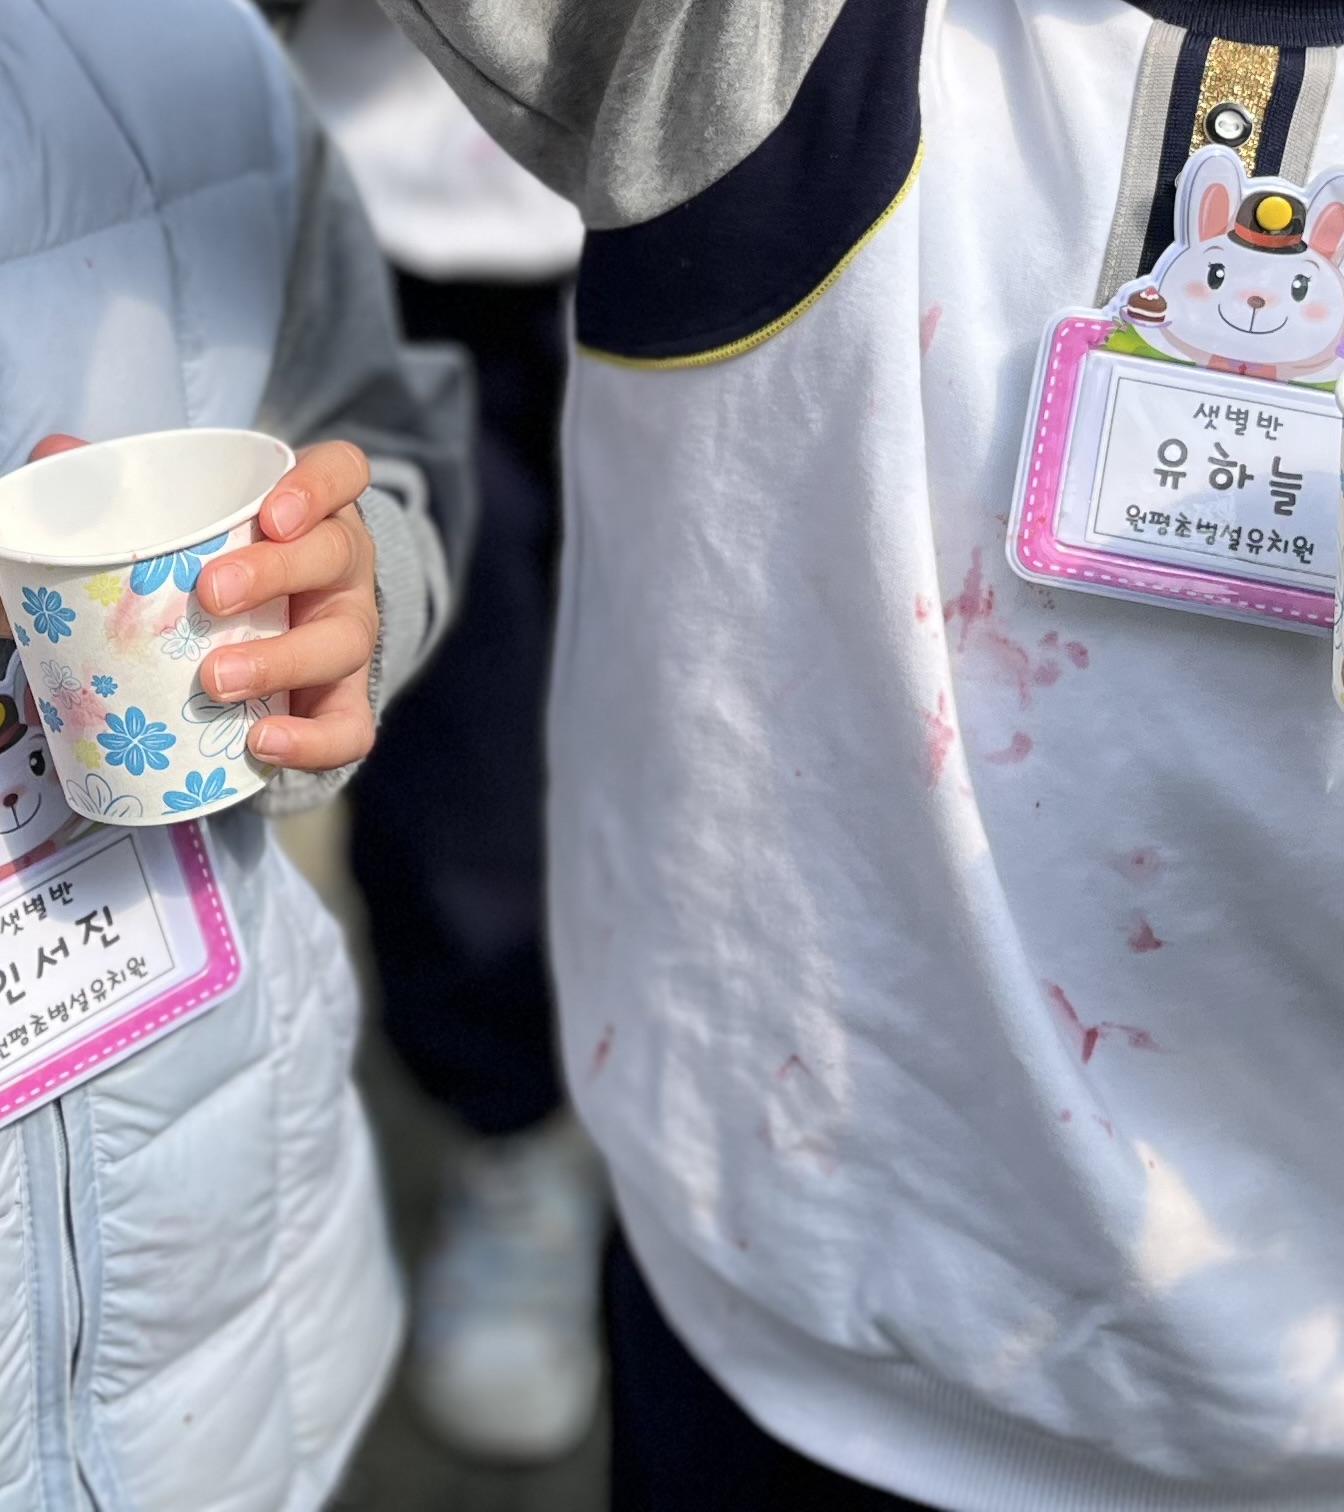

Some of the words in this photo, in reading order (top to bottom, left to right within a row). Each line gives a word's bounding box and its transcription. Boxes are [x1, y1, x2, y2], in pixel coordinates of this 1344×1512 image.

[1192, 402, 1284, 441] 샛별반
[1153, 438, 1304, 517] 유하늘
[1125, 503, 1315, 565] 원평초병설유치원
[0, 880, 74, 936] 샛별반
